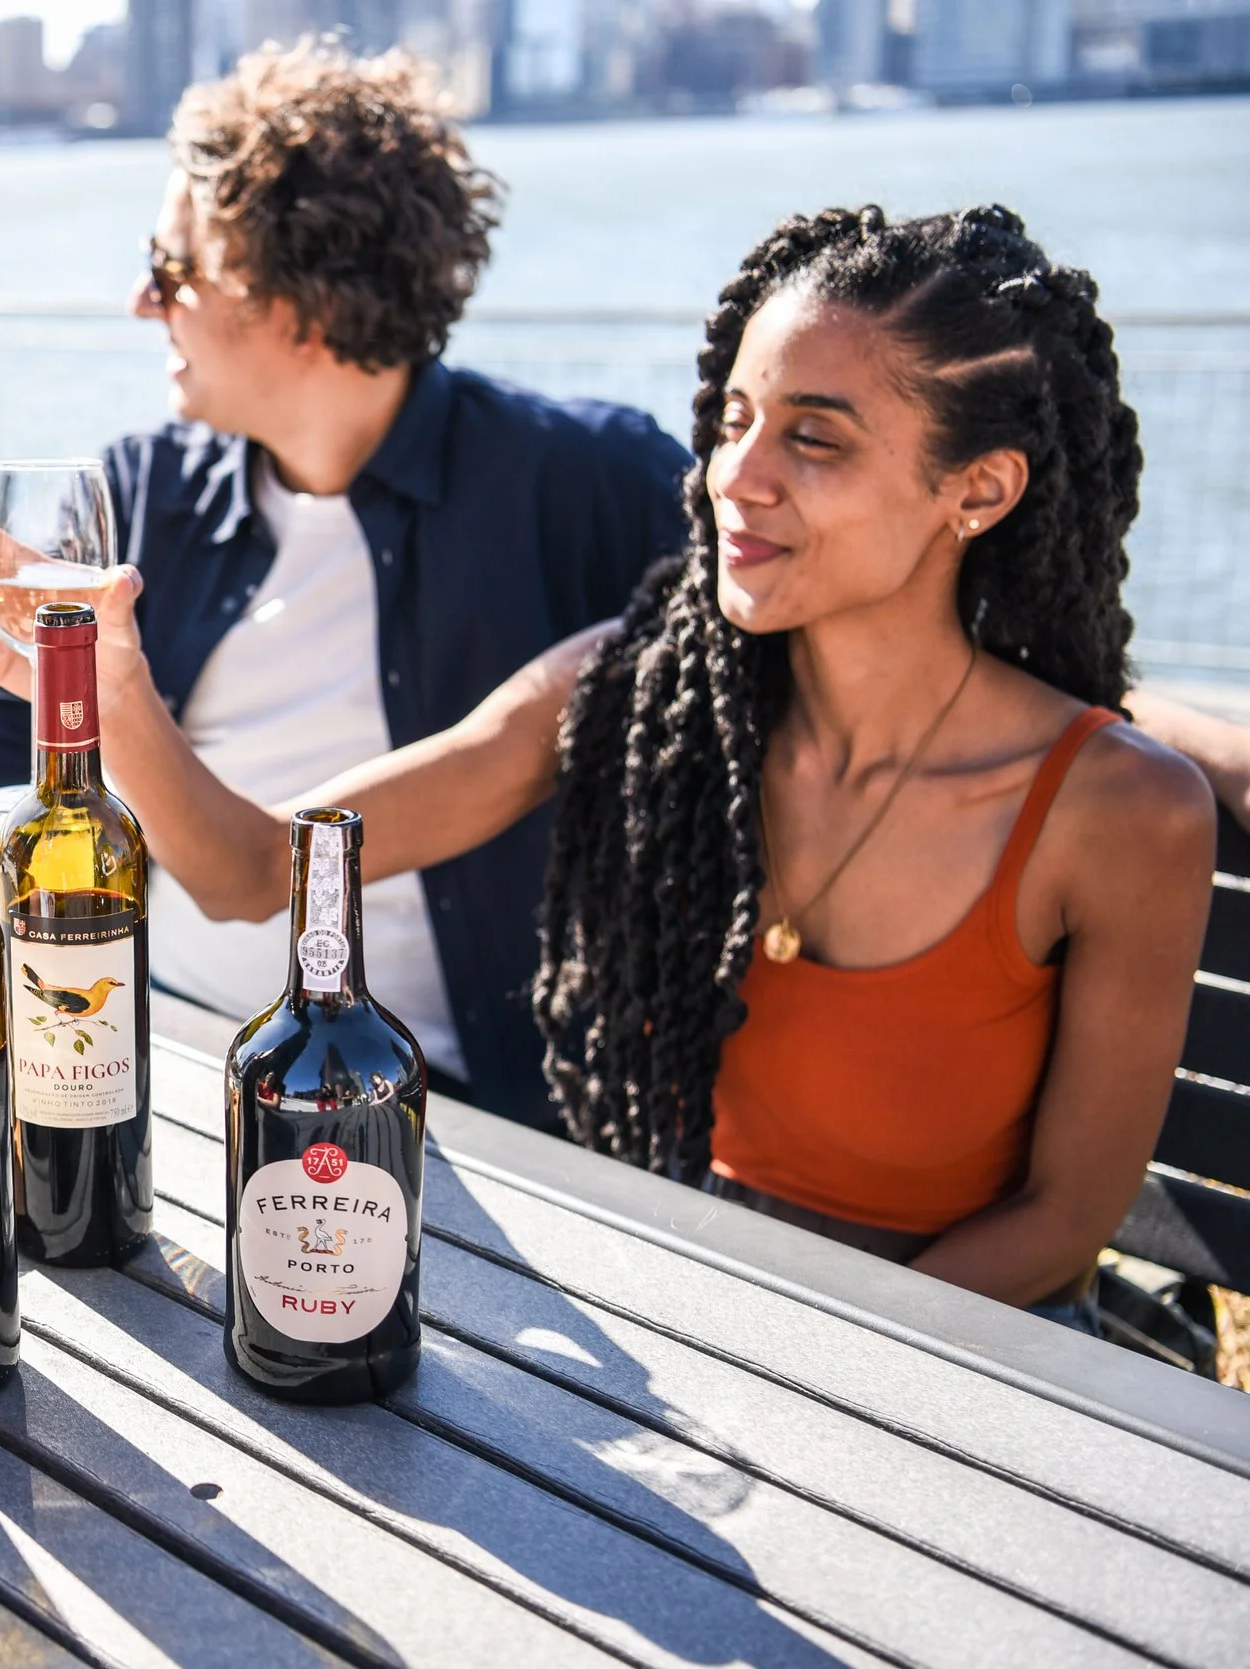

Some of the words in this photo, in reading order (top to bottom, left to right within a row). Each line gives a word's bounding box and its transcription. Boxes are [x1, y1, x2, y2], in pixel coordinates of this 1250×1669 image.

[29, 931, 56, 940] CASA
[60, 926, 130, 941] FERREIRINHA
[302, 947, 344, 959] 955137
[19, 1058, 65, 1080] PAPA
[72, 1057, 130, 1080] FIGOS
[54, 1083, 93, 1091] DOURO
[256, 1195, 391, 1223] FERREIRA
[287, 1260, 355, 1274] PORTO
[282, 1294, 357, 1315] RUBY
